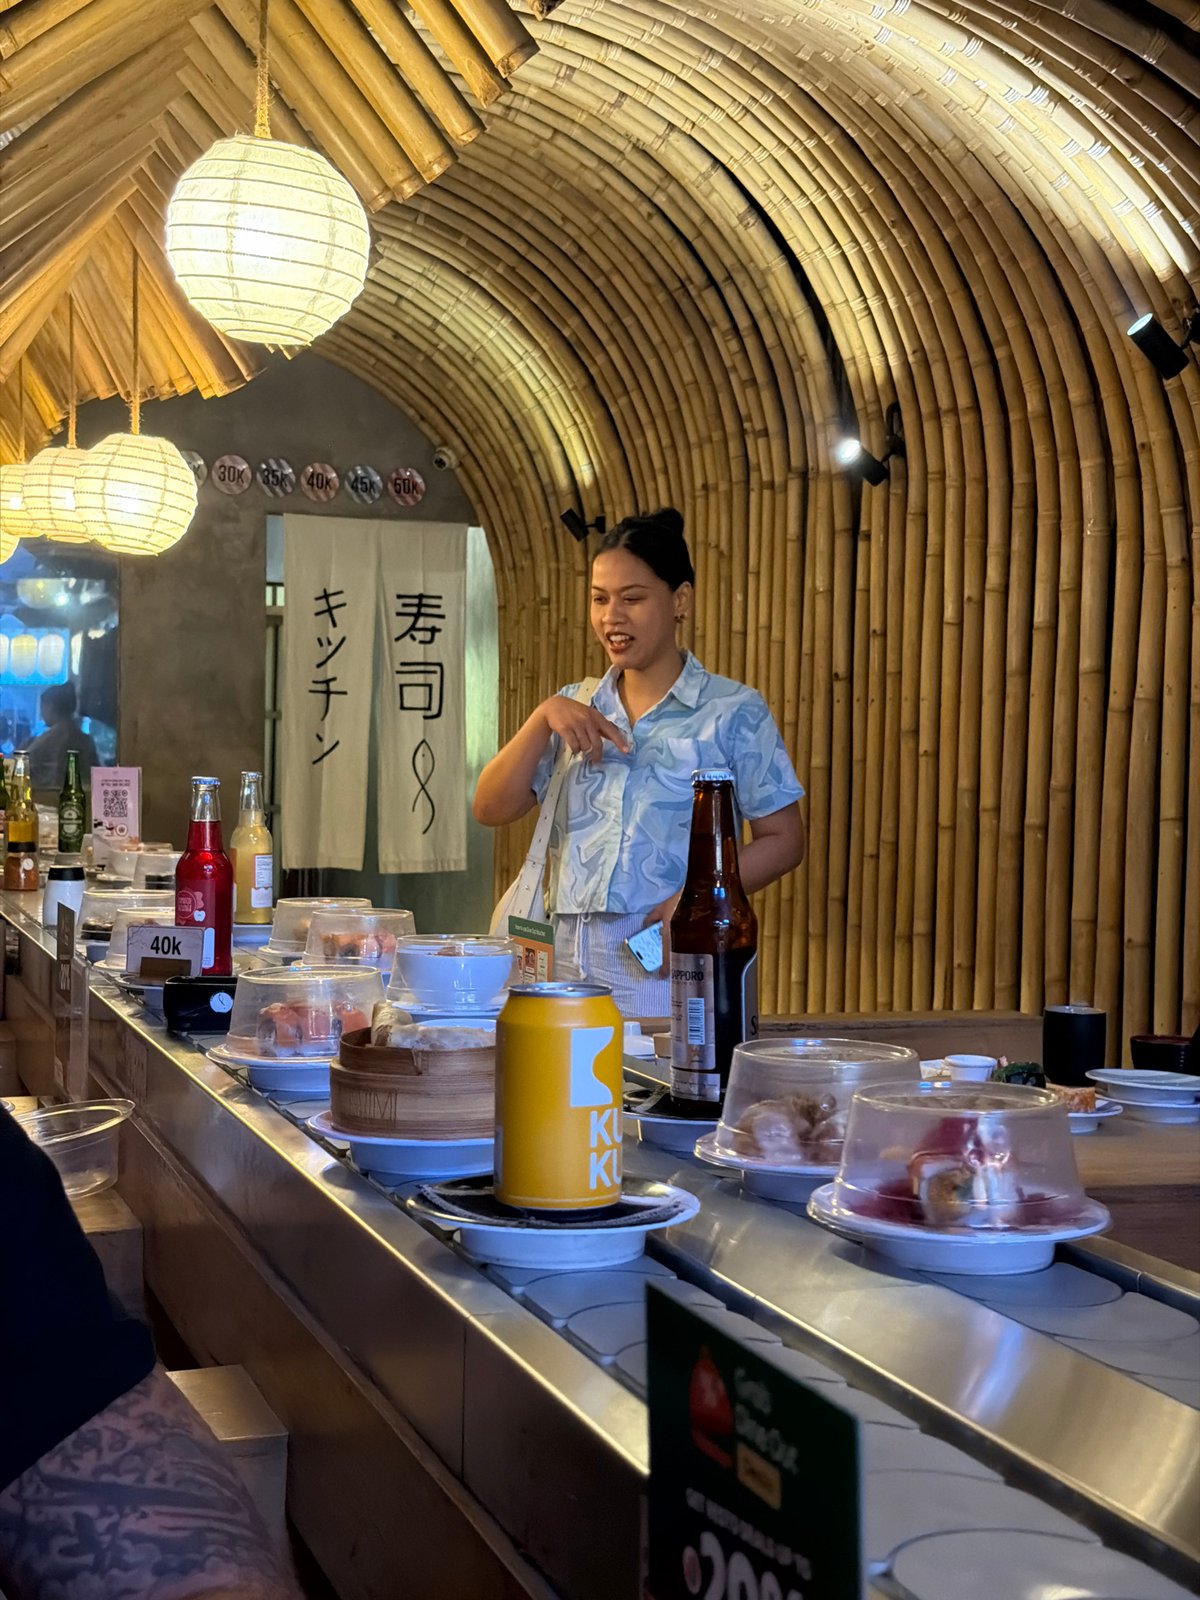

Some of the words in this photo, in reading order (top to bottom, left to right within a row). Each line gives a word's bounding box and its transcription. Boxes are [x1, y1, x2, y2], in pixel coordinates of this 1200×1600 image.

[218, 464, 246, 484] 30K
[262, 468, 288, 488] 35K
[307, 471, 333, 491] 40K
[351, 475, 376, 495] 45K
[394, 477, 419, 496] 50K
[394, 593, 446, 720] 寿司
[308, 588, 348, 765] キッチン
[150, 936, 182, 955] 40k
